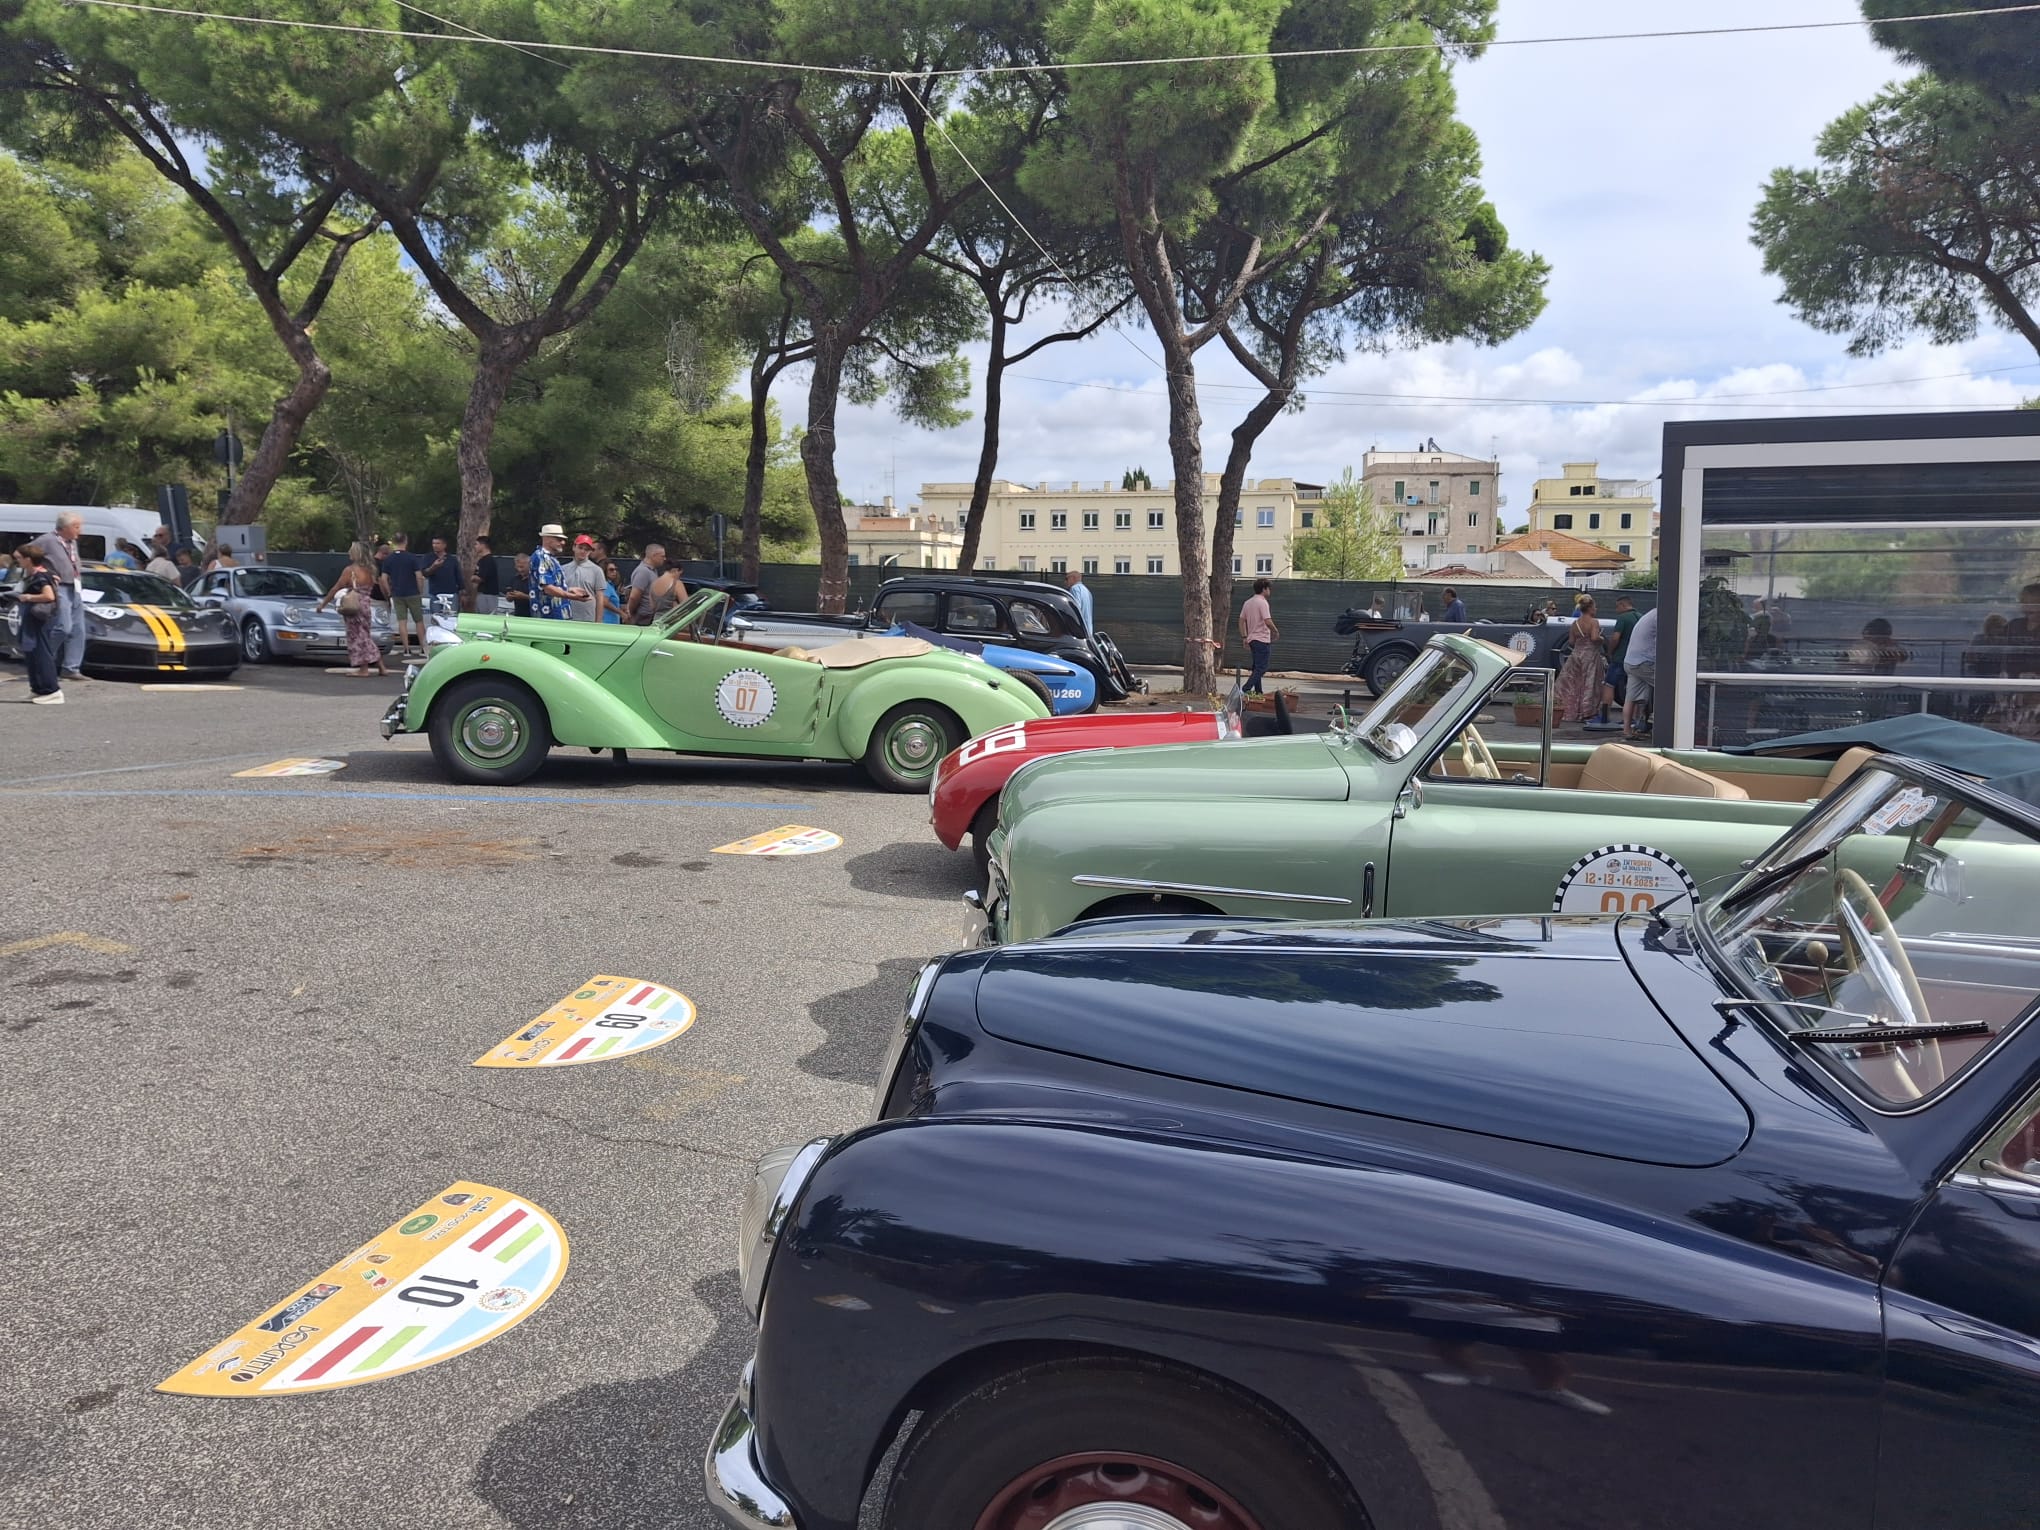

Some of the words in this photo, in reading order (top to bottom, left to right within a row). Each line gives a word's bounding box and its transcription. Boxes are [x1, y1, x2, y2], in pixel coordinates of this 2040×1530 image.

[1516, 640, 1528, 652] 03
[735, 687, 759, 711] 07
[1634, 879, 1654, 888] 2025
[398, 1274, 480, 1308] 10
